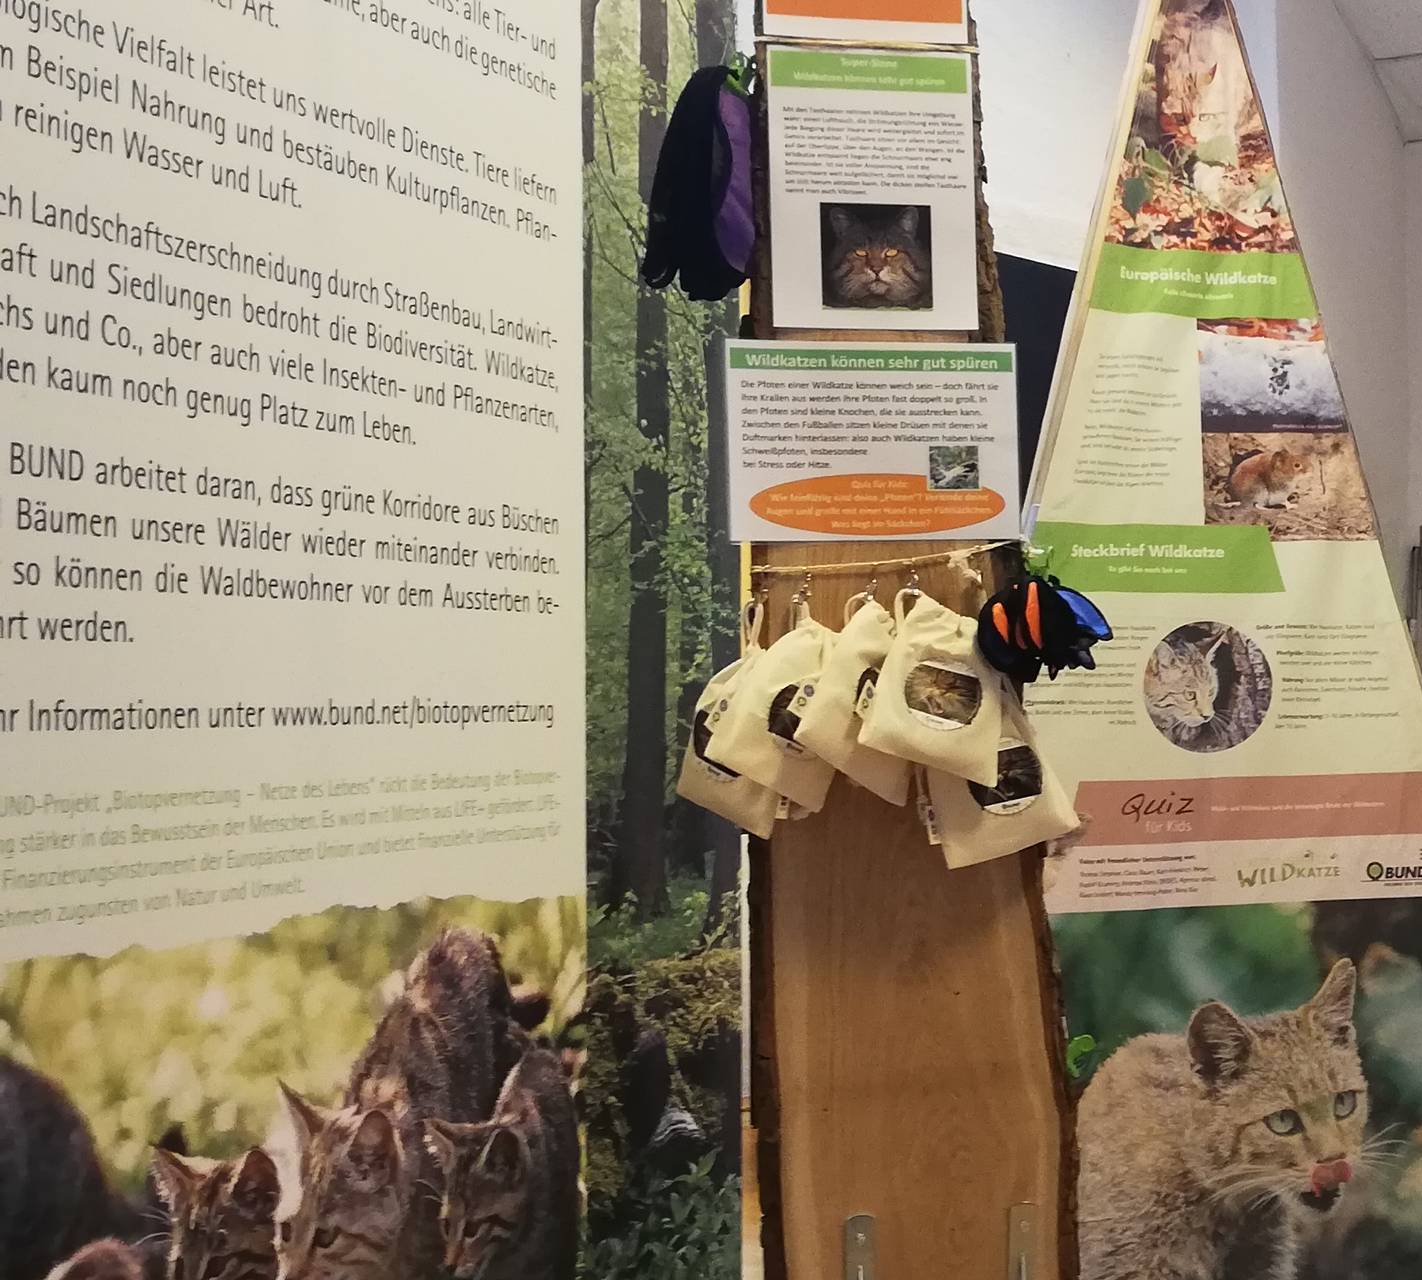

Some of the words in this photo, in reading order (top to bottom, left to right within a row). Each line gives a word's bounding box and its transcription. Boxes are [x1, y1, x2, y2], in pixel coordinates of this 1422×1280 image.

[464, 2, 490, 30] alle
[494, 9, 527, 41] Tier-
[532, 34, 556, 60] und
[369, 1, 407, 33] aber
[411, 22, 450, 53] auch
[455, 35, 478, 65] die
[482, 52, 557, 100] genetische
[899, 77, 914, 87] gut
[112, 21, 195, 79] Vielfalt
[203, 54, 266, 103] leistet
[273, 88, 307, 117] uns
[312, 102, 396, 149] wertvolle
[401, 126, 469, 173] Dienste.
[472, 151, 510, 188] Tiere
[514, 168, 557, 205] liefern
[15, 103, 112, 154] reinigen
[123, 128, 204, 179] Wasser
[212, 163, 249, 193] und
[259, 169, 302, 208] Luft.
[27, 44, 119, 104] Beispiel
[132, 79, 226, 145] Nahrung
[237, 123, 273, 152] und
[283, 129, 378, 186] bestäuben
[386, 164, 510, 228] Kulturpflanzen.
[514, 208, 557, 241] Pflan-
[32, 191, 322, 299] Landschaftszerschneidung
[328, 269, 379, 305] durch
[384, 282, 485, 336] Straßenbau,
[490, 309, 557, 349] Landwirt-
[1120, 266, 1200, 284] Europäische
[1205, 270, 1277, 285] Wildkatze
[50, 258, 95, 289] und
[108, 263, 231, 321] Siedlungen
[243, 293, 320, 338] bedroht
[329, 314, 359, 345] die
[364, 321, 477, 371] Biodiversität.
[485, 349, 558, 392] Wildkatze,
[745, 353, 827, 368] Wildkatzen
[831, 354, 885, 369] können
[888, 355, 918, 370] sehr
[923, 357, 946, 371] gut
[950, 357, 998, 372] spüren
[812, 381, 853, 389] Wildkatze
[791, 407, 808, 415] sind
[10, 442, 86, 481] BUND
[94, 456, 187, 494] arbeitet
[196, 466, 261, 507] daran,
[270, 475, 314, 507] dass
[319, 485, 375, 517] grüne
[382, 489, 461, 524] Korridore
[468, 507, 496, 528] aus
[500, 504, 559, 535] Büschen
[16, 497, 117, 538] Bäumen
[131, 518, 205, 545] unsere
[217, 517, 292, 552] Wälder
[301, 527, 367, 558] wieder
[374, 534, 479, 568] miteinander
[485, 546, 560, 574] verbinden.
[1071, 543, 1146, 558] Steckbrief
[1149, 544, 1225, 558] Wildkatze
[12, 561, 41, 586] so
[54, 555, 143, 591] können
[155, 562, 189, 594] die
[200, 565, 354, 603] Waldbewohner
[361, 584, 391, 604] vor
[397, 580, 433, 607] dem
[442, 583, 531, 613] Aussterben
[536, 589, 560, 614] be-
[37, 610, 135, 643] werden.
[28, 699, 199, 732] Informationen
[208, 702, 265, 728] unter
[271, 696, 554, 730] www.bund.net/biotopvernetzung
[1121, 791, 1194, 823] Quiz
[101, 828, 127, 846] das
[1145, 821, 1163, 833] für
[1167, 820, 1192, 833] Kids
[1237, 863, 1341, 888] WILDKATZE
